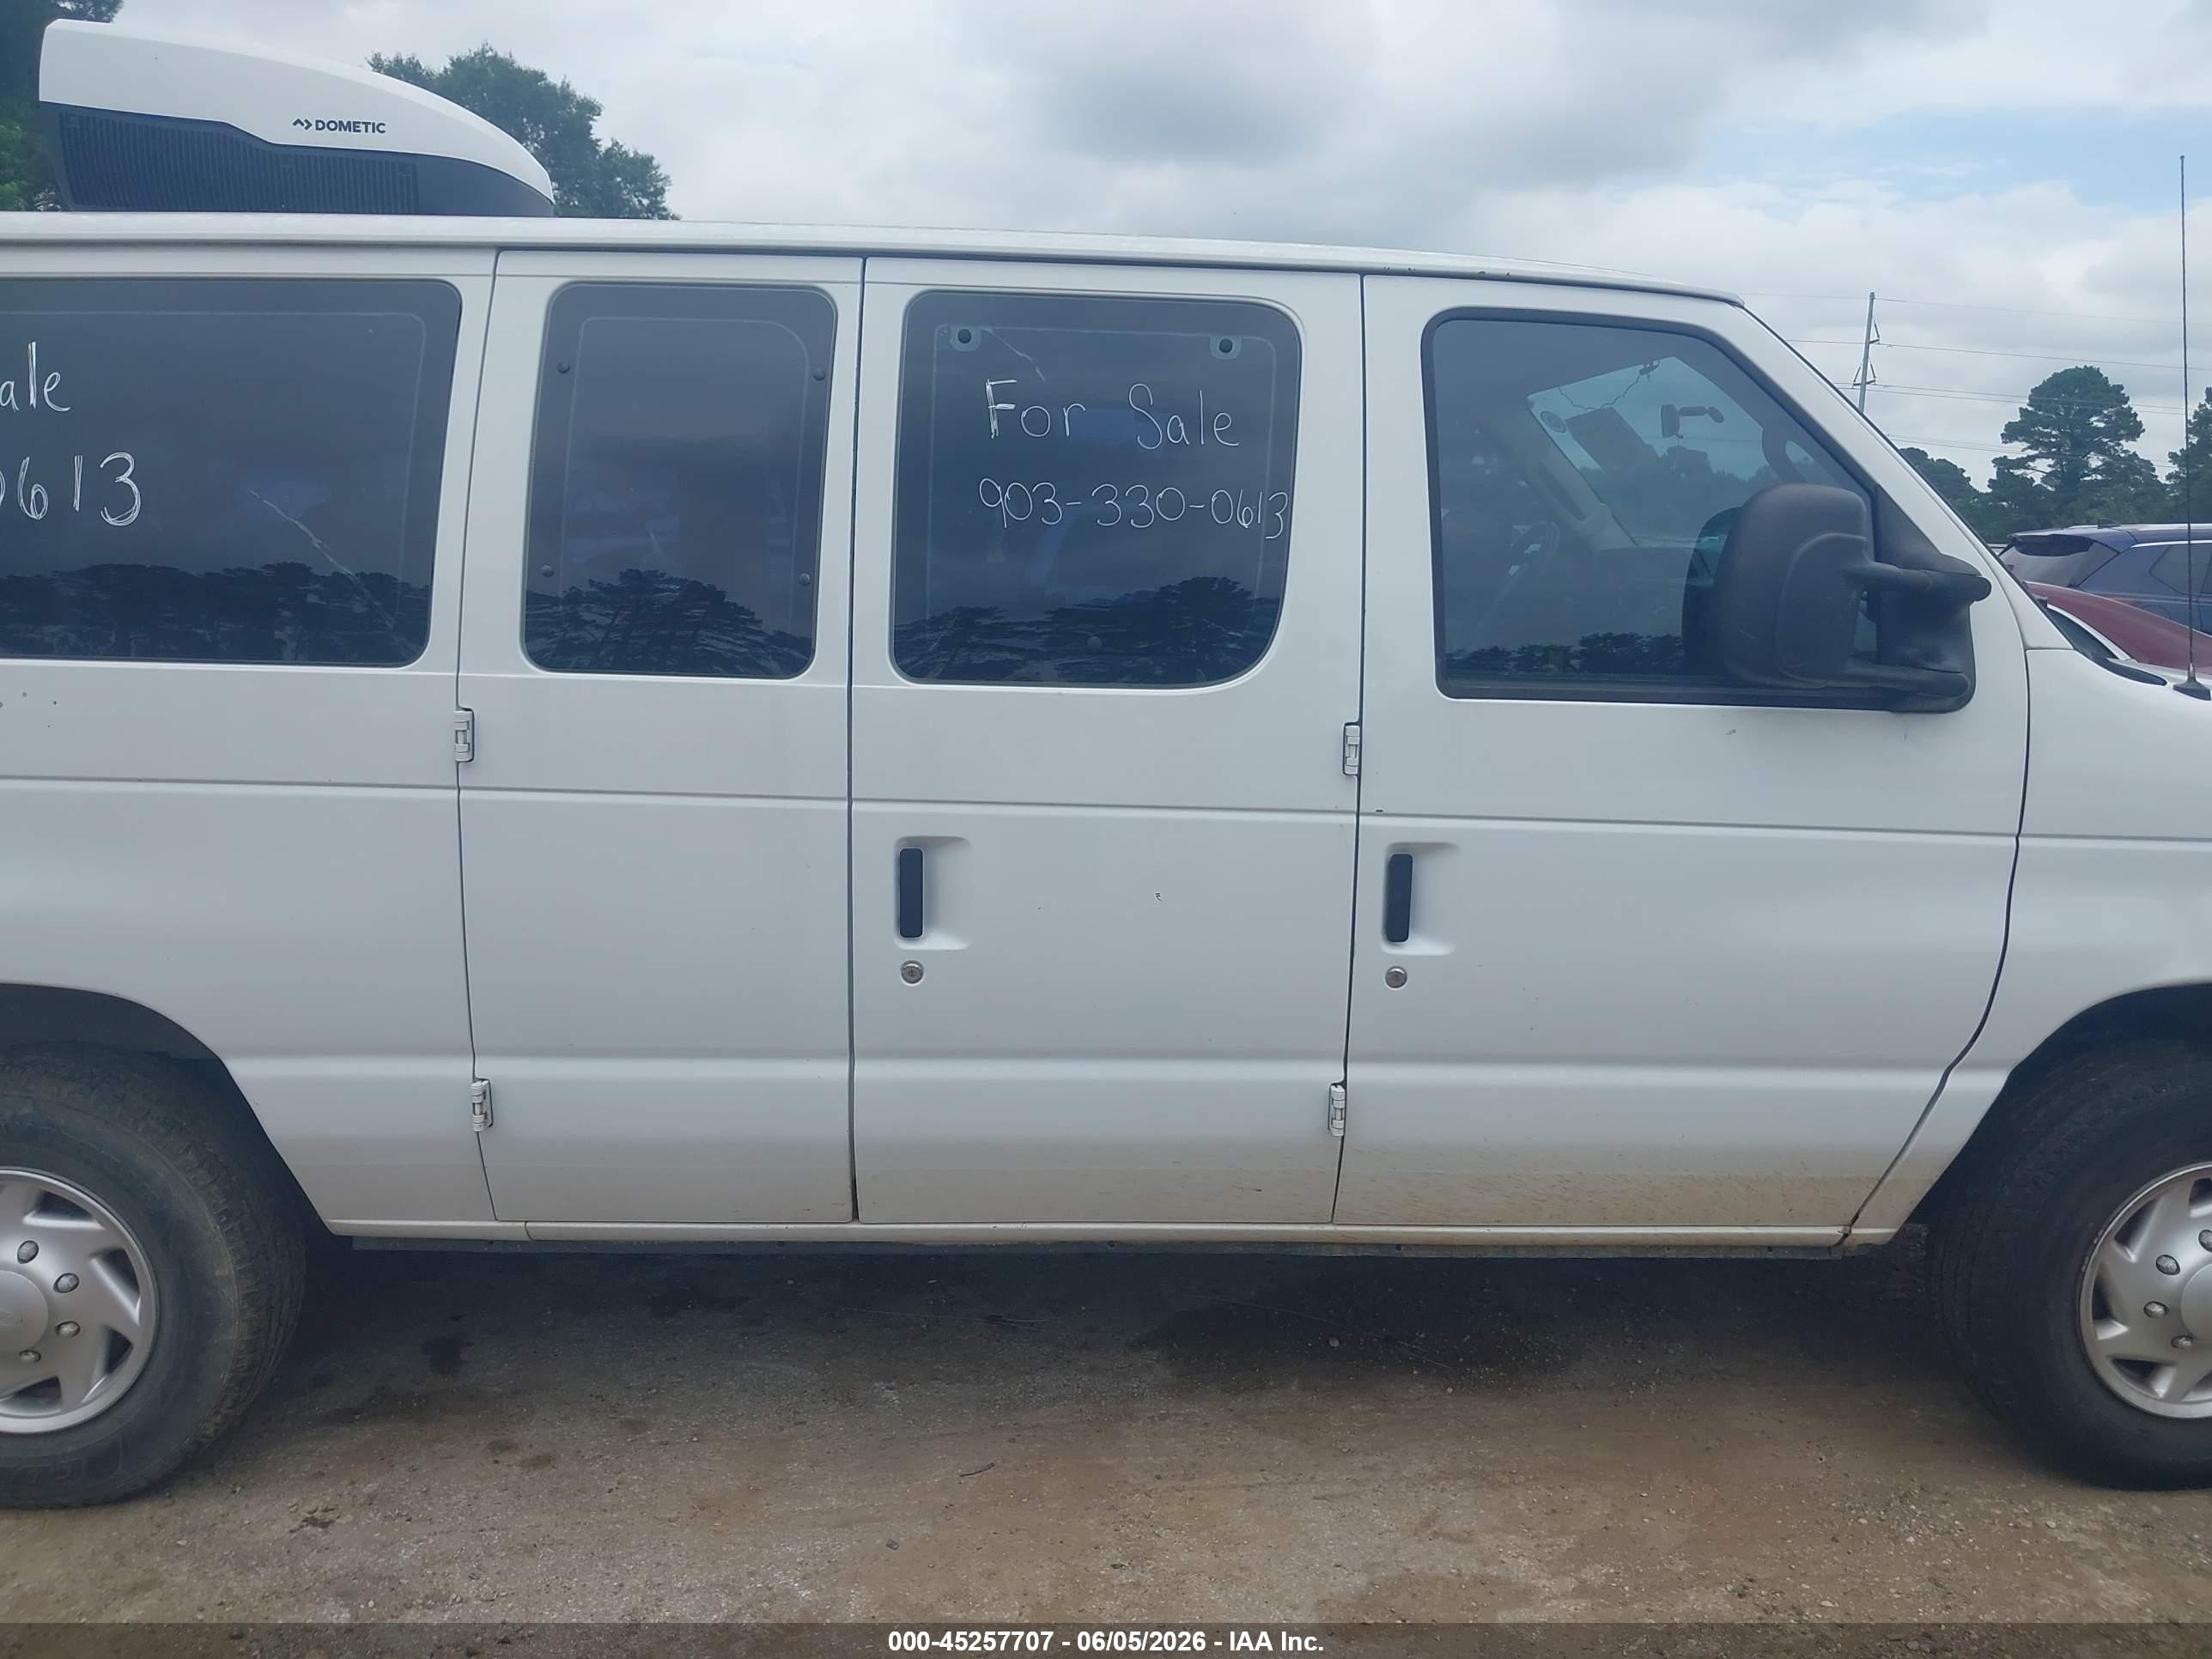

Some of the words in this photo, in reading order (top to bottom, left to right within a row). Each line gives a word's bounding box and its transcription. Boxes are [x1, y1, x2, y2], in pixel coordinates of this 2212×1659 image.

[314, 119, 386, 134] DOMETIC
[986, 379, 1086, 439] For
[1128, 383, 1240, 450] Sale
[0, 452, 142, 527] 613
[979, 477, 1289, 539] 903-330-0613
